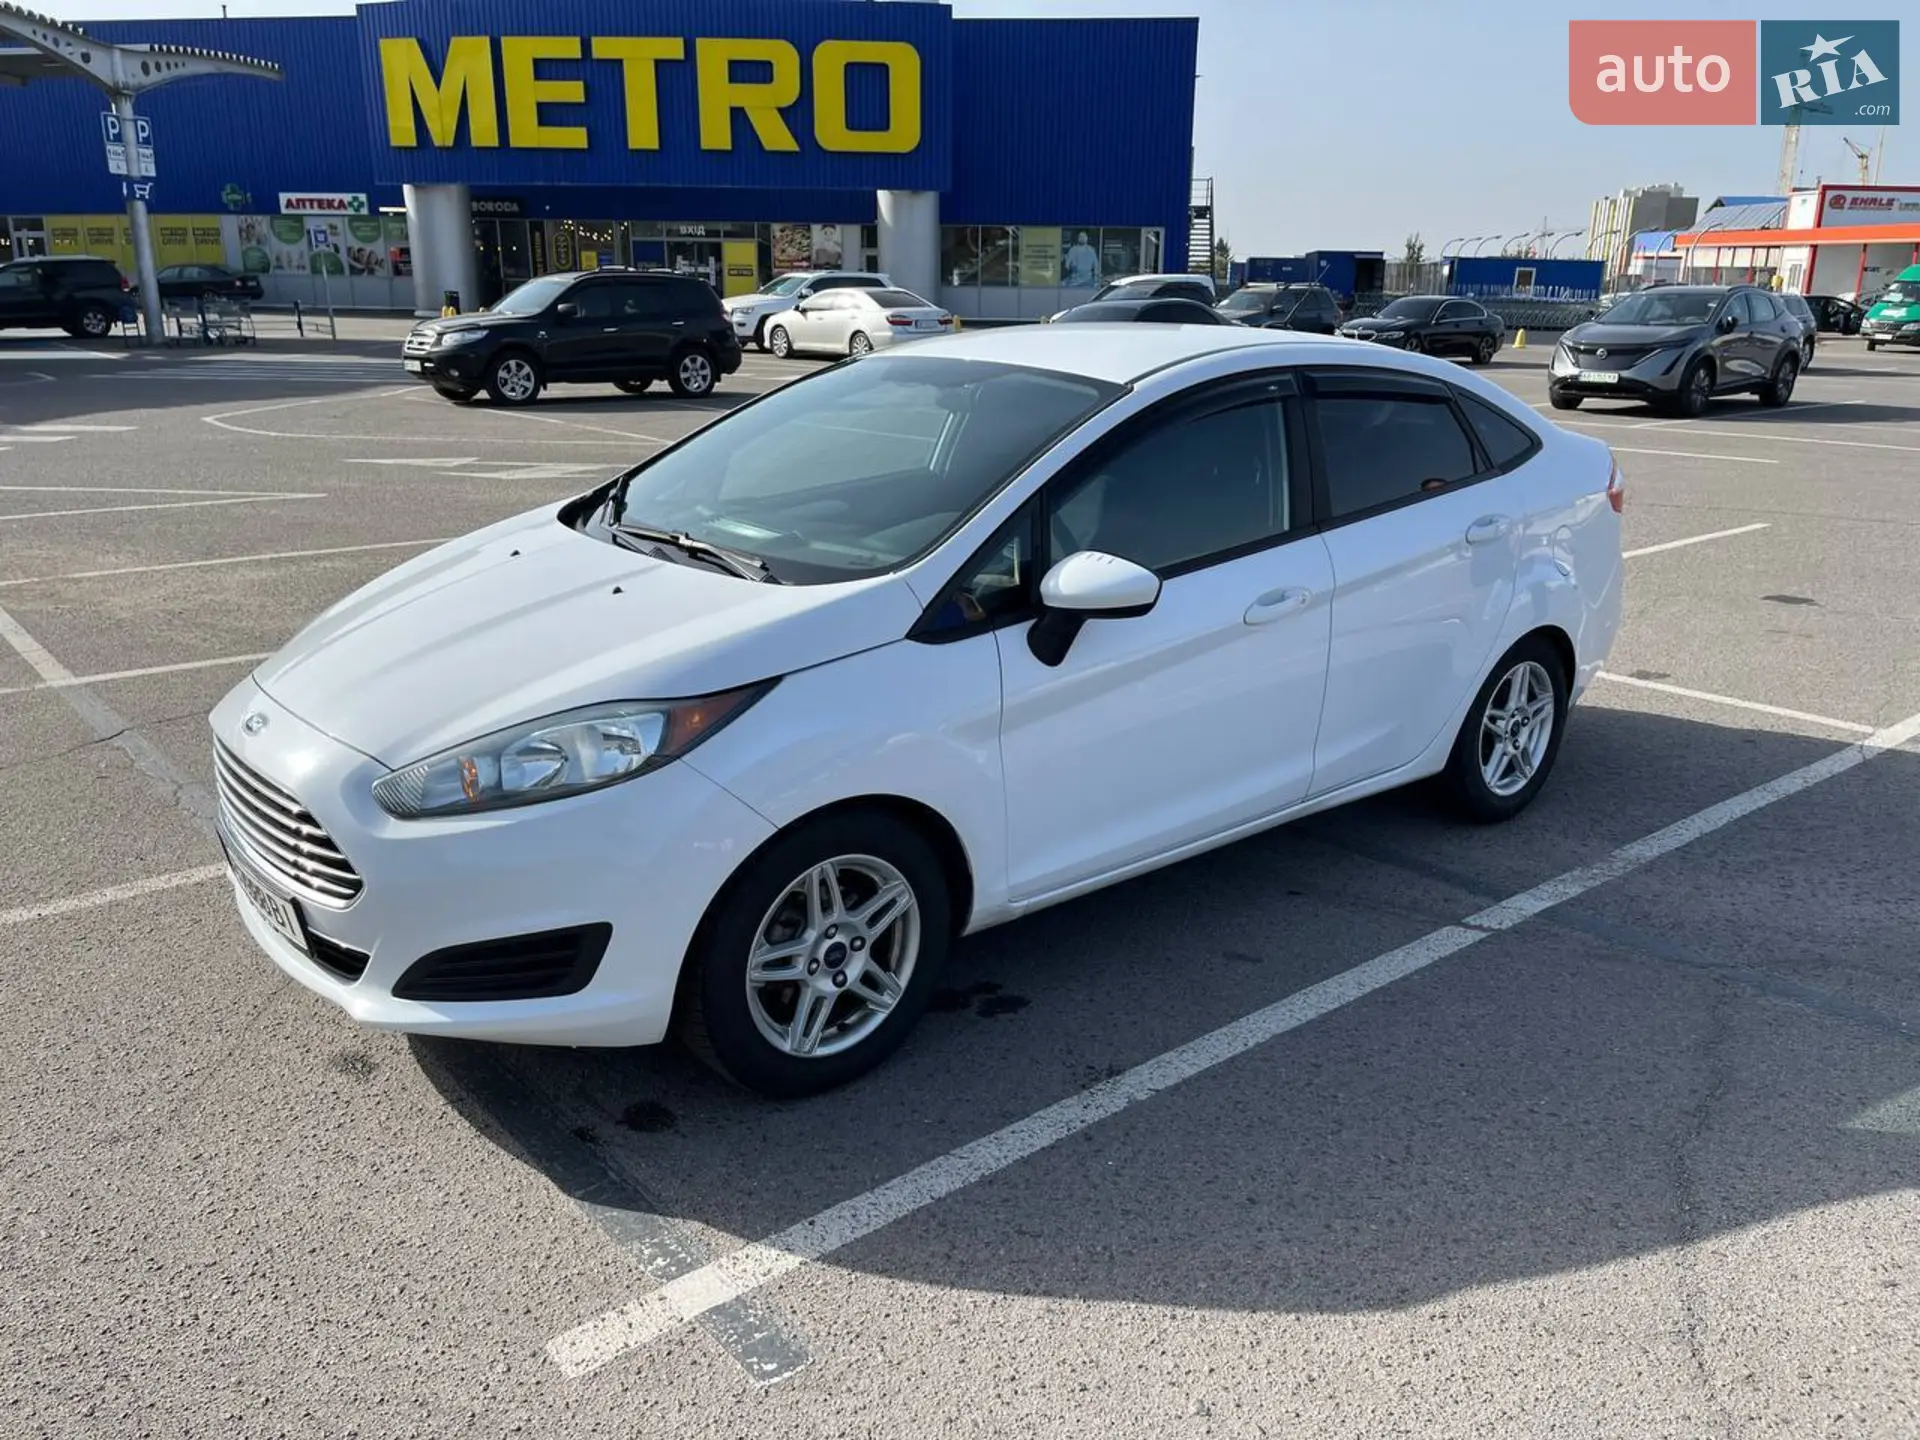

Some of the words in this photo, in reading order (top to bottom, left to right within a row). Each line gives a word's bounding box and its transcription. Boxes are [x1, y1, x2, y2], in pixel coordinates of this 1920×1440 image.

[379, 36, 921, 153] METRO
[107, 116, 119, 140] P
[137, 120, 149, 143] P
[285, 198, 348, 210] АПТЕКА
[680, 225, 705, 236] ВХІД
